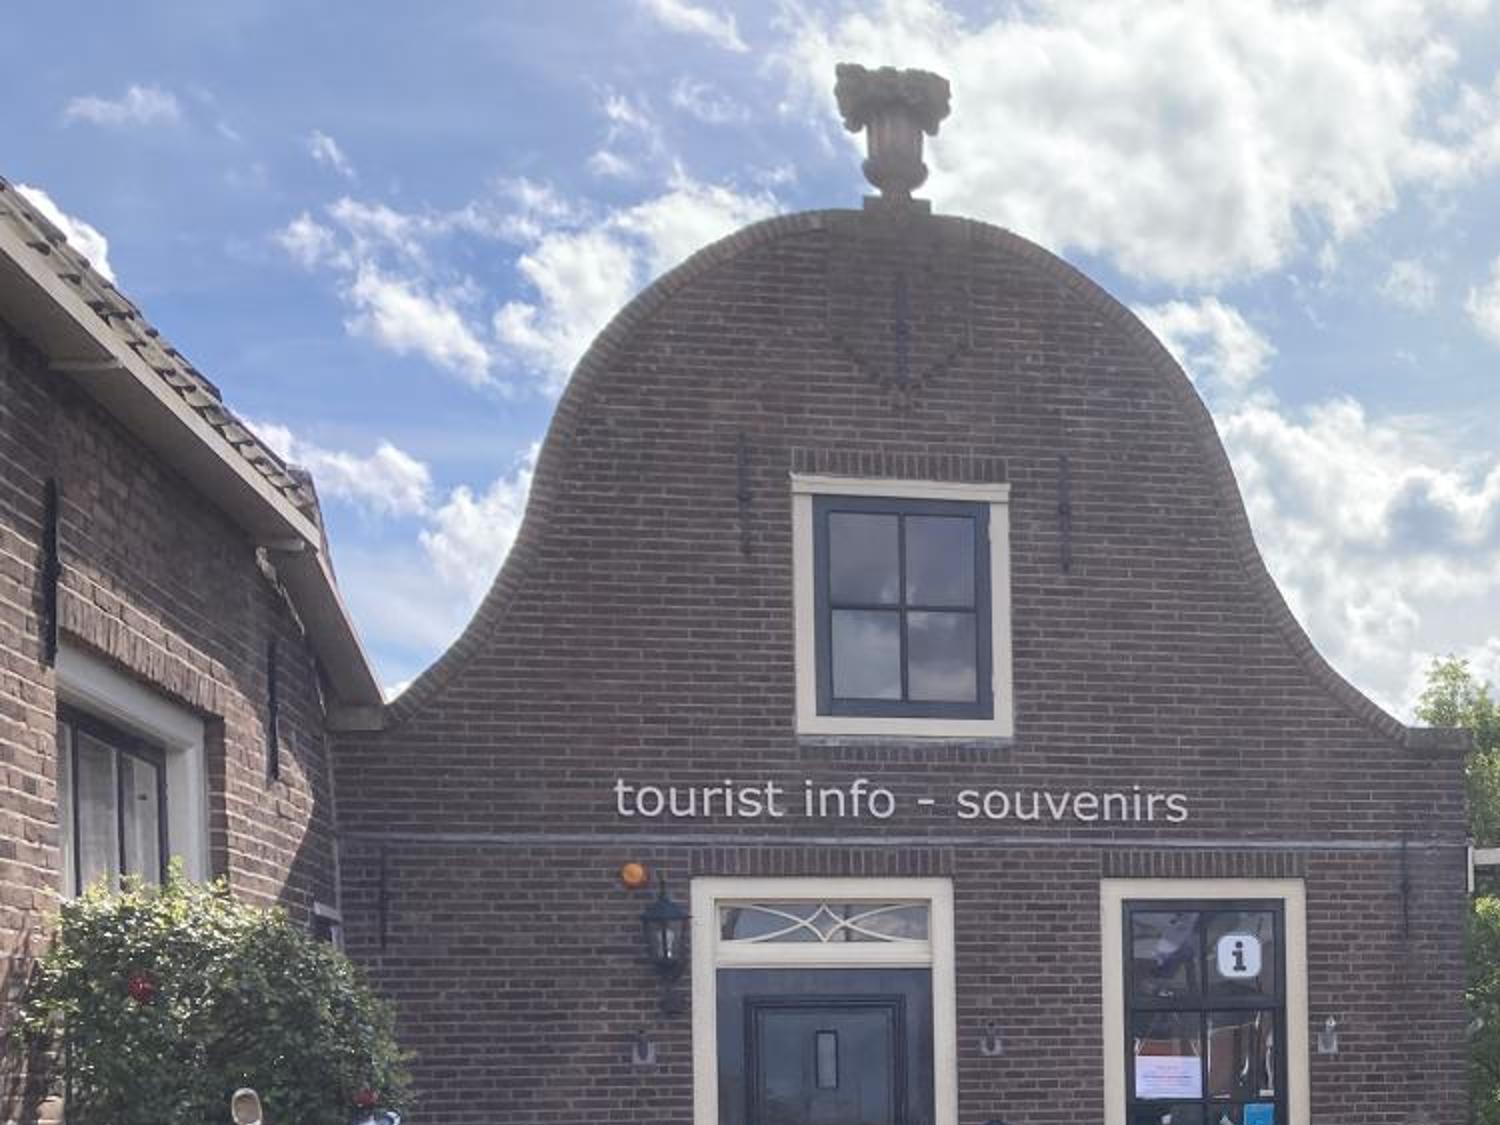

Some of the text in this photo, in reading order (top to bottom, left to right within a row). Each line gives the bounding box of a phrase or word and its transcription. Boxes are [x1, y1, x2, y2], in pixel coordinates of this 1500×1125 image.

[613, 777, 787, 818] tourist
[804, 777, 896, 819] info
[956, 784, 1189, 823] souvenirs
